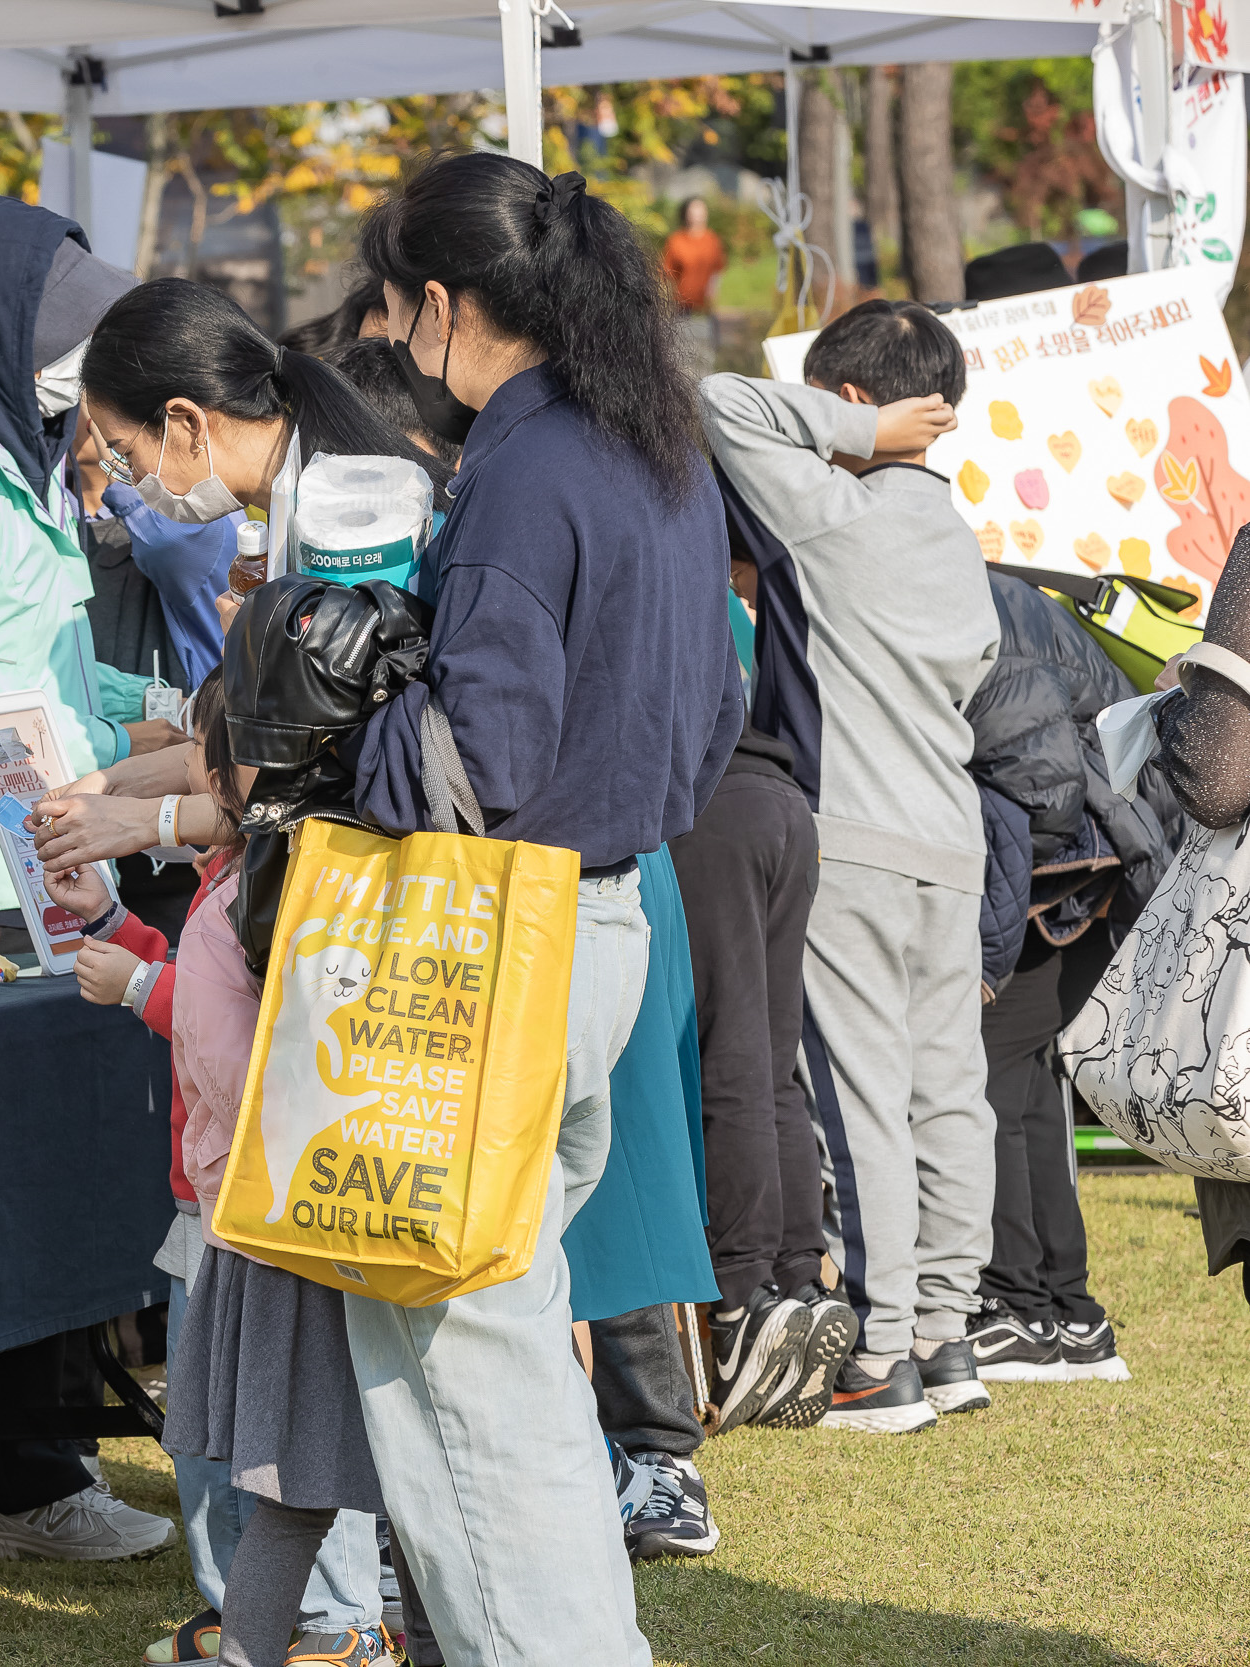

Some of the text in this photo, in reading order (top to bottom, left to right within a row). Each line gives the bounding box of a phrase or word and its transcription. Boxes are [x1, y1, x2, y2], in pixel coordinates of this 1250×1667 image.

[1036, 328, 1092, 358] 소망을
[1095, 298, 1192, 347] 적어주세요!
[310, 552, 383, 568] 200매로 더 오래
[164, 810, 172, 824] 291
[312, 866, 372, 908] I'M
[327, 912, 489, 955] & CUTE. AND
[133, 978, 144, 993] 290
[373, 951, 484, 992] I LOVE
[365, 986, 477, 1028] CLEAN
[350, 1017, 475, 1064] WATER.
[348, 1053, 466, 1096] PLEASE
[381, 1091, 461, 1127] SAVE
[340, 1117, 456, 1159] WATER!
[309, 1147, 449, 1212] SAVE
[292, 1199, 440, 1249] OUR LIFE!
